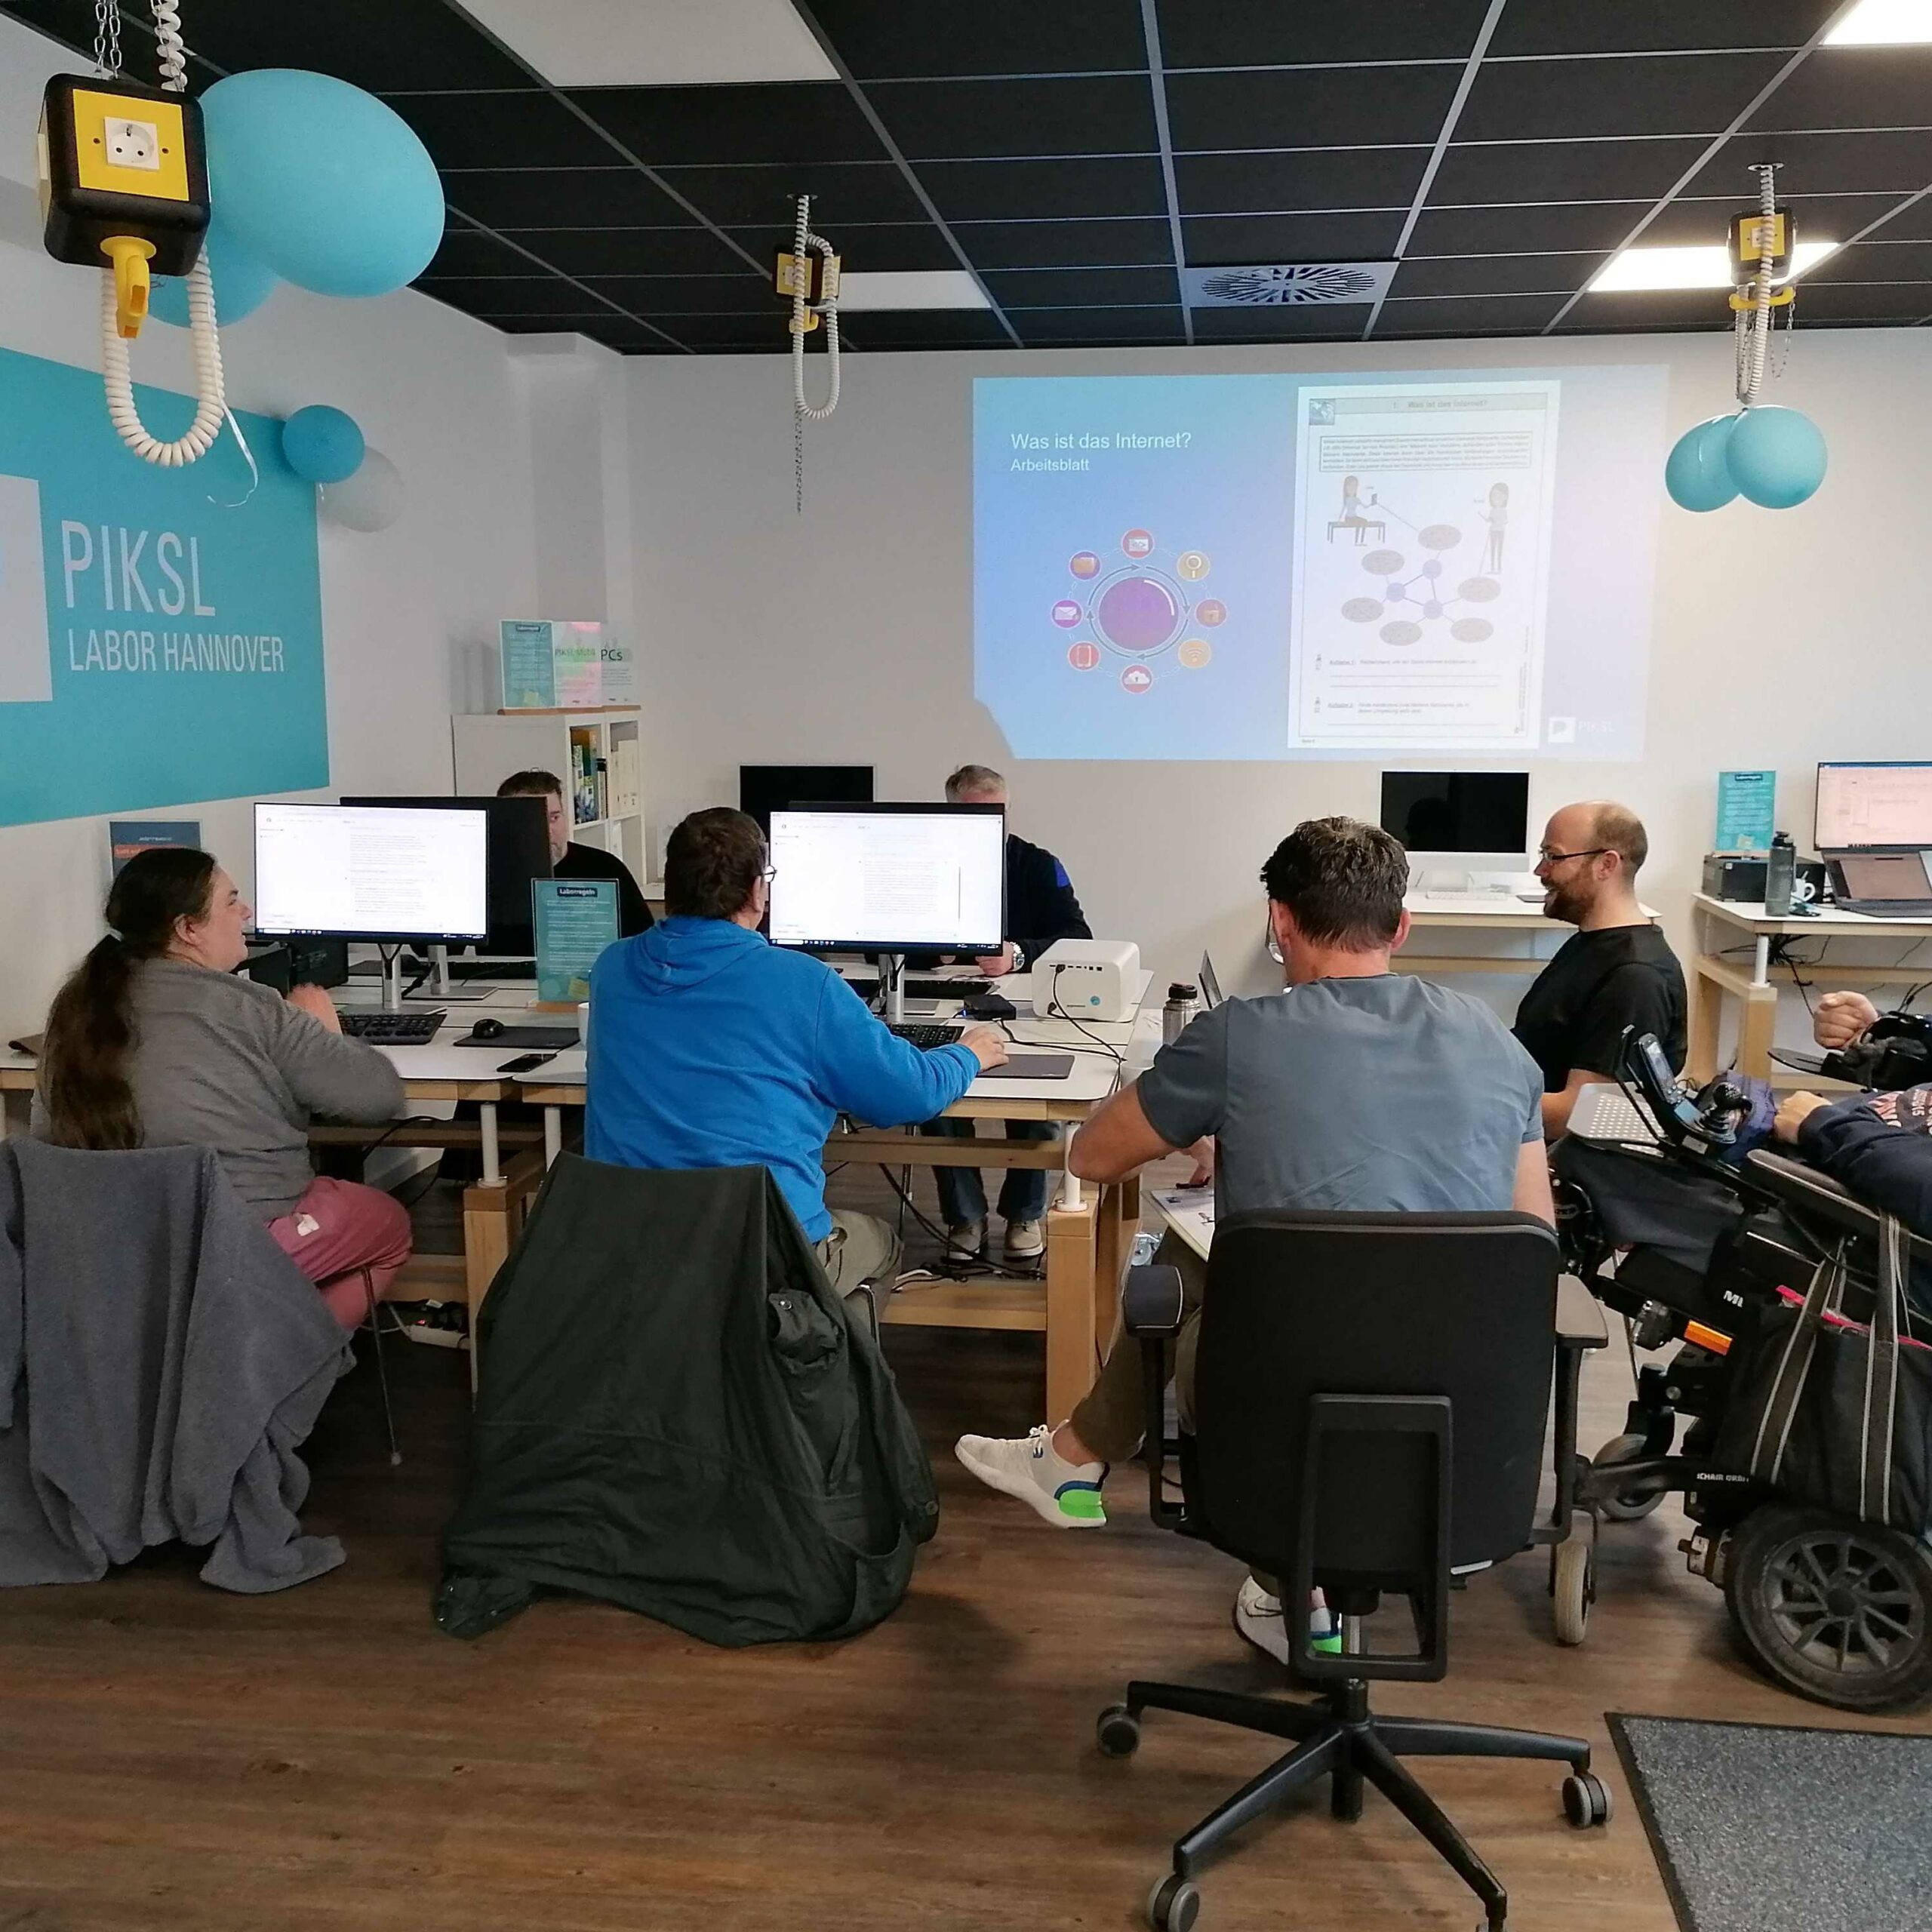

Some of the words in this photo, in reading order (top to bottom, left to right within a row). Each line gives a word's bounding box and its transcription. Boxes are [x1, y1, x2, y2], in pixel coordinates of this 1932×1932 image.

[1011, 433, 1049, 449] Was
[1055, 432, 1074, 449] ist
[1079, 432, 1110, 449] das
[1116, 432, 1192, 449] Internet?
[1011, 458, 1090, 472] Arbeitsblatt
[62, 520, 216, 617] PIKSL
[68, 629, 156, 672] LABOR
[164, 632, 285, 672] HANNOVER
[601, 649, 623, 661] PCs
